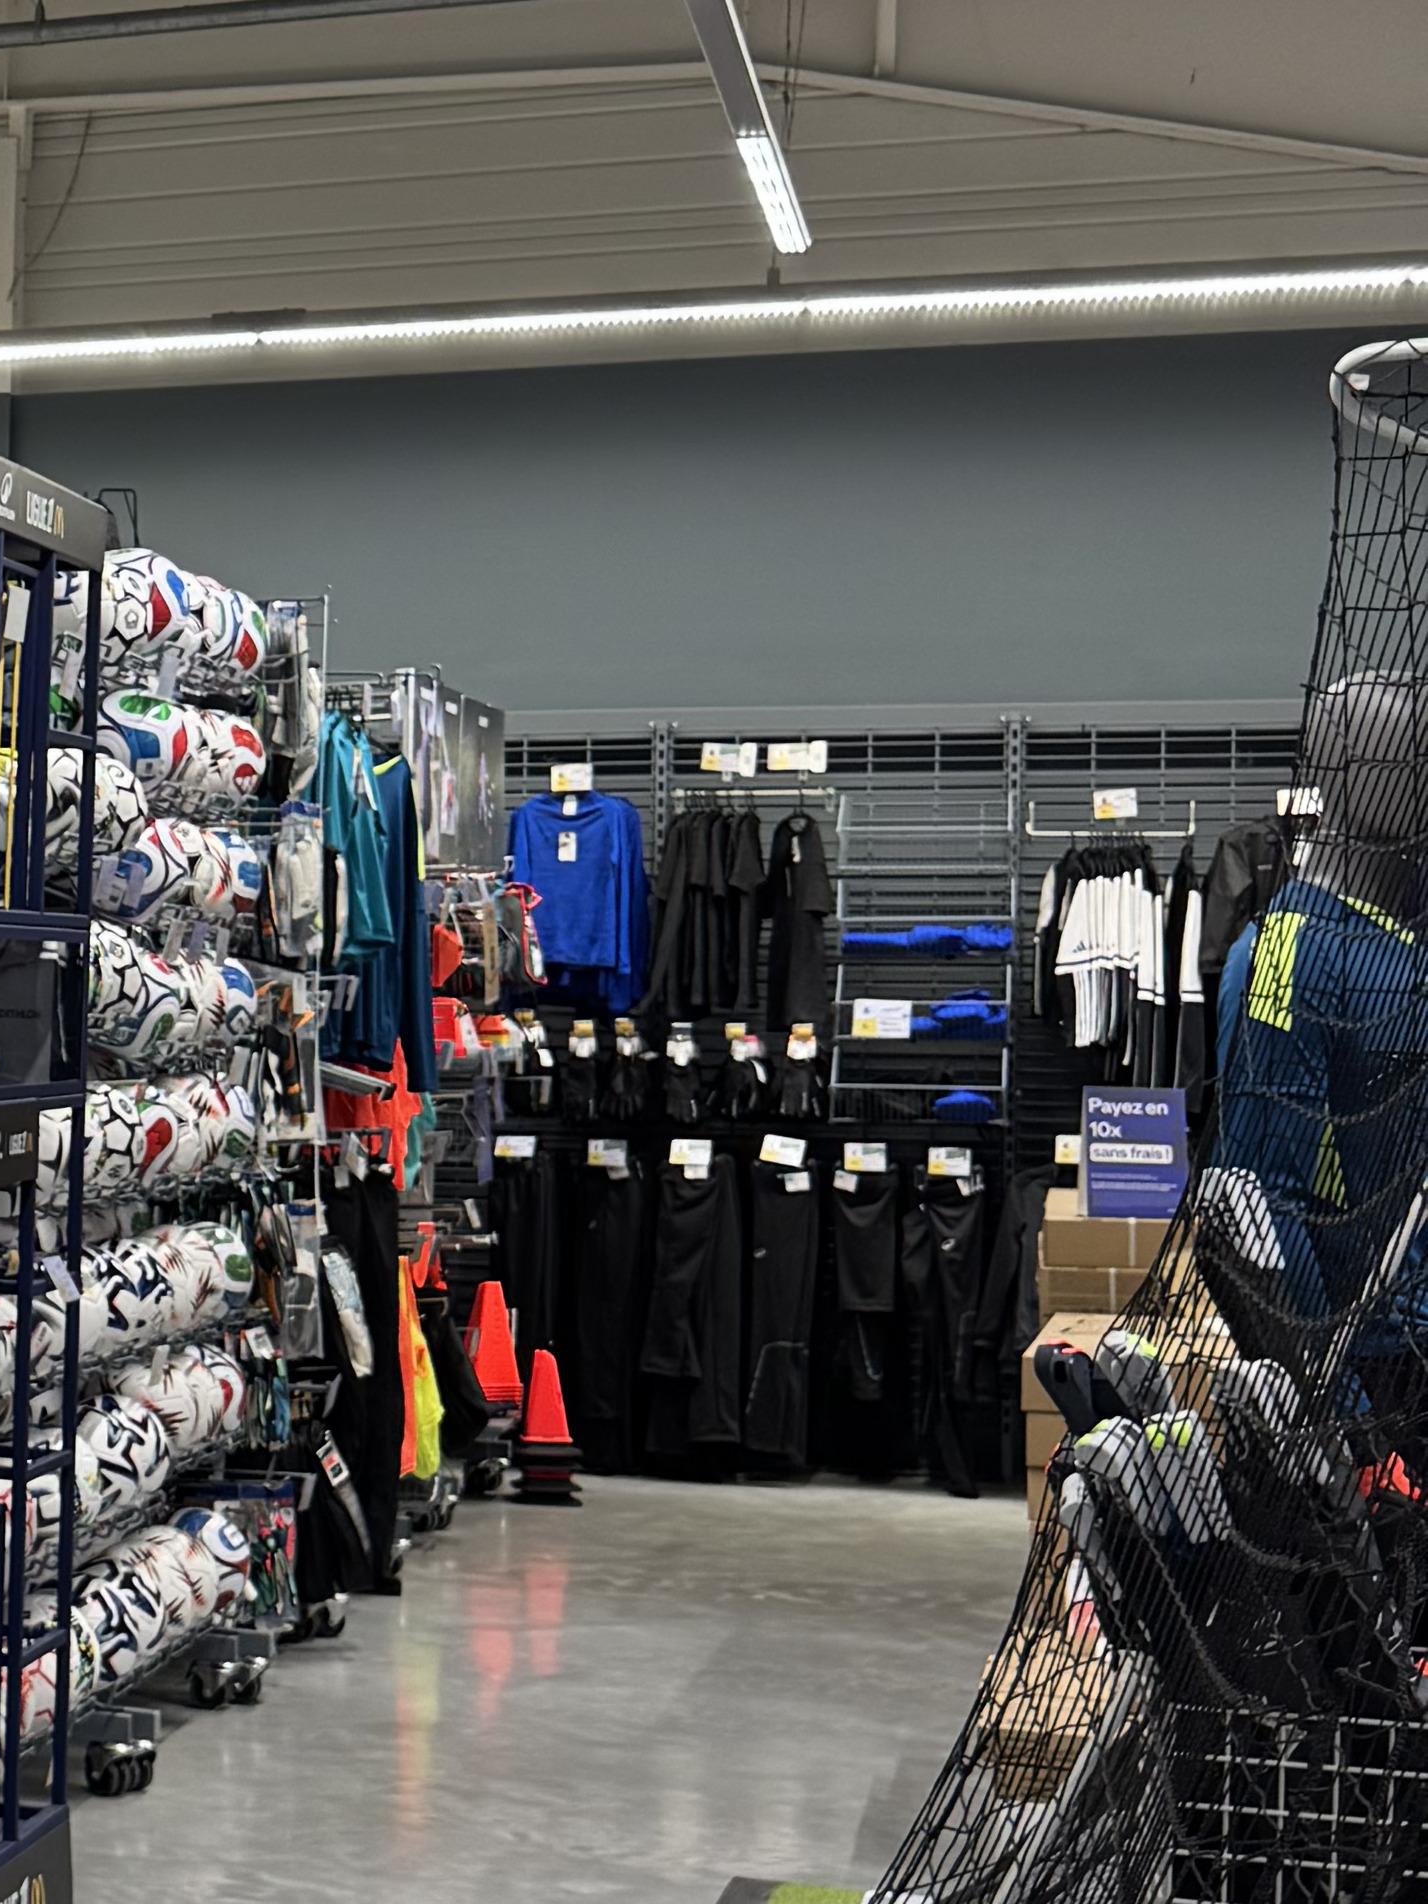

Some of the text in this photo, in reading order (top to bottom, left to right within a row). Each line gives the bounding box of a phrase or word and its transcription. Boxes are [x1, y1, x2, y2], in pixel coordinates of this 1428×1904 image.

[1088, 1097, 1168, 1118] Payez en
[1089, 1121, 1122, 1138] 10x
[1093, 1149, 1128, 1159] sans
[1131, 1146, 1162, 1159] frais
